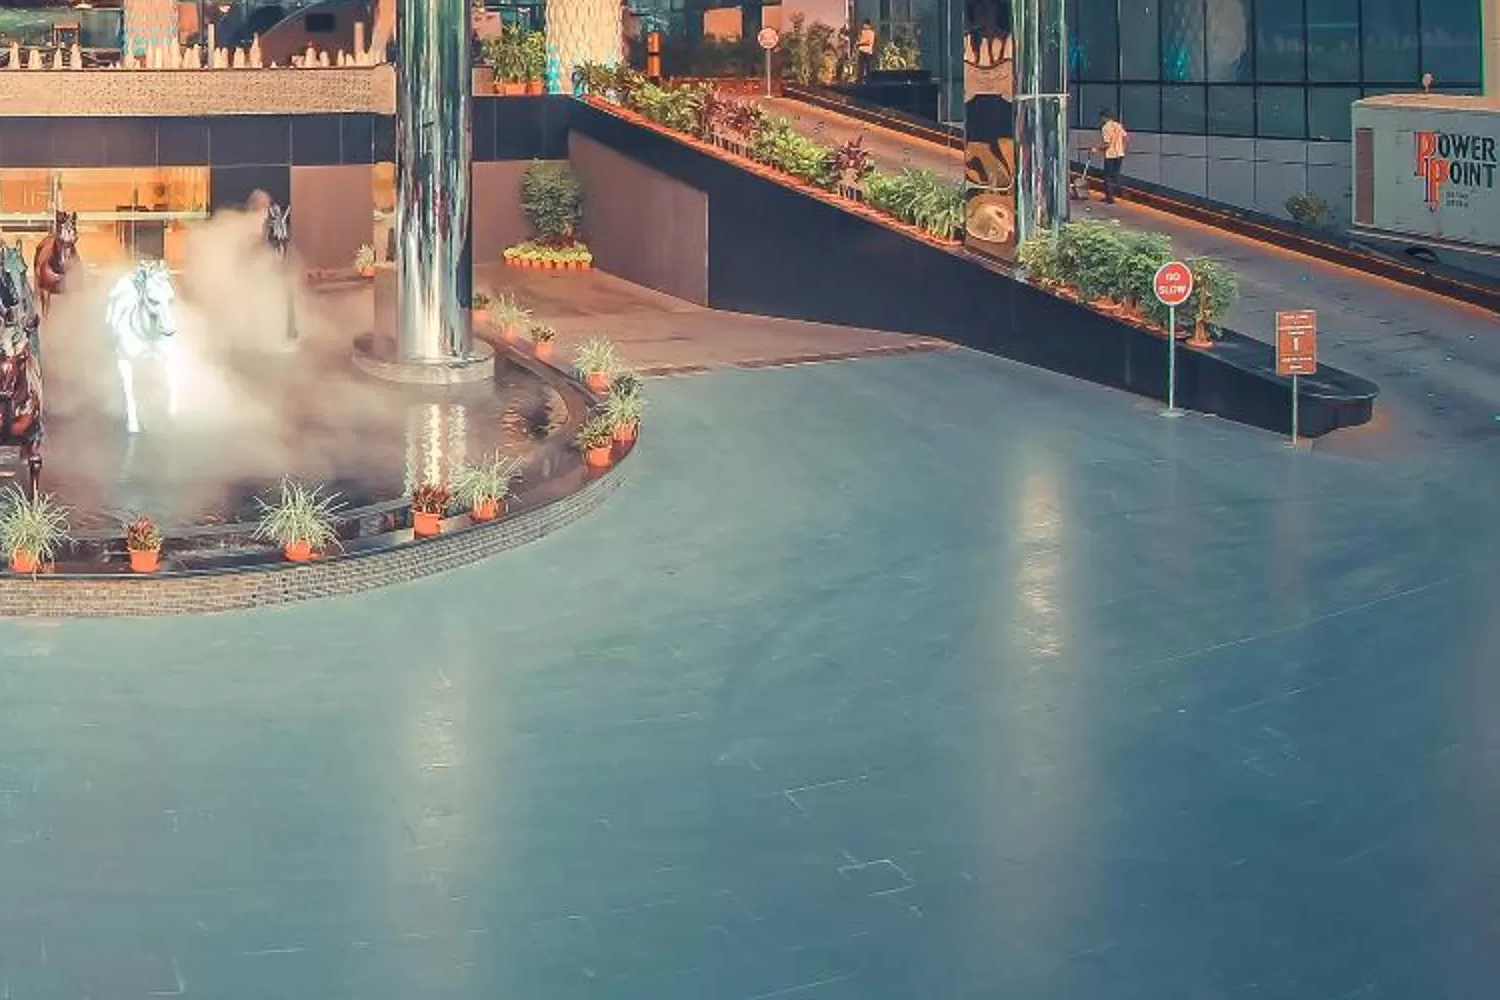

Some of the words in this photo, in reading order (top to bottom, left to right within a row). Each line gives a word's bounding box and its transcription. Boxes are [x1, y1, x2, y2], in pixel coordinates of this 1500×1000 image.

[1413, 130, 1497, 177] POWER
[1424, 157, 1497, 203] POINT
[1158, 284, 1187, 294] SLOW
